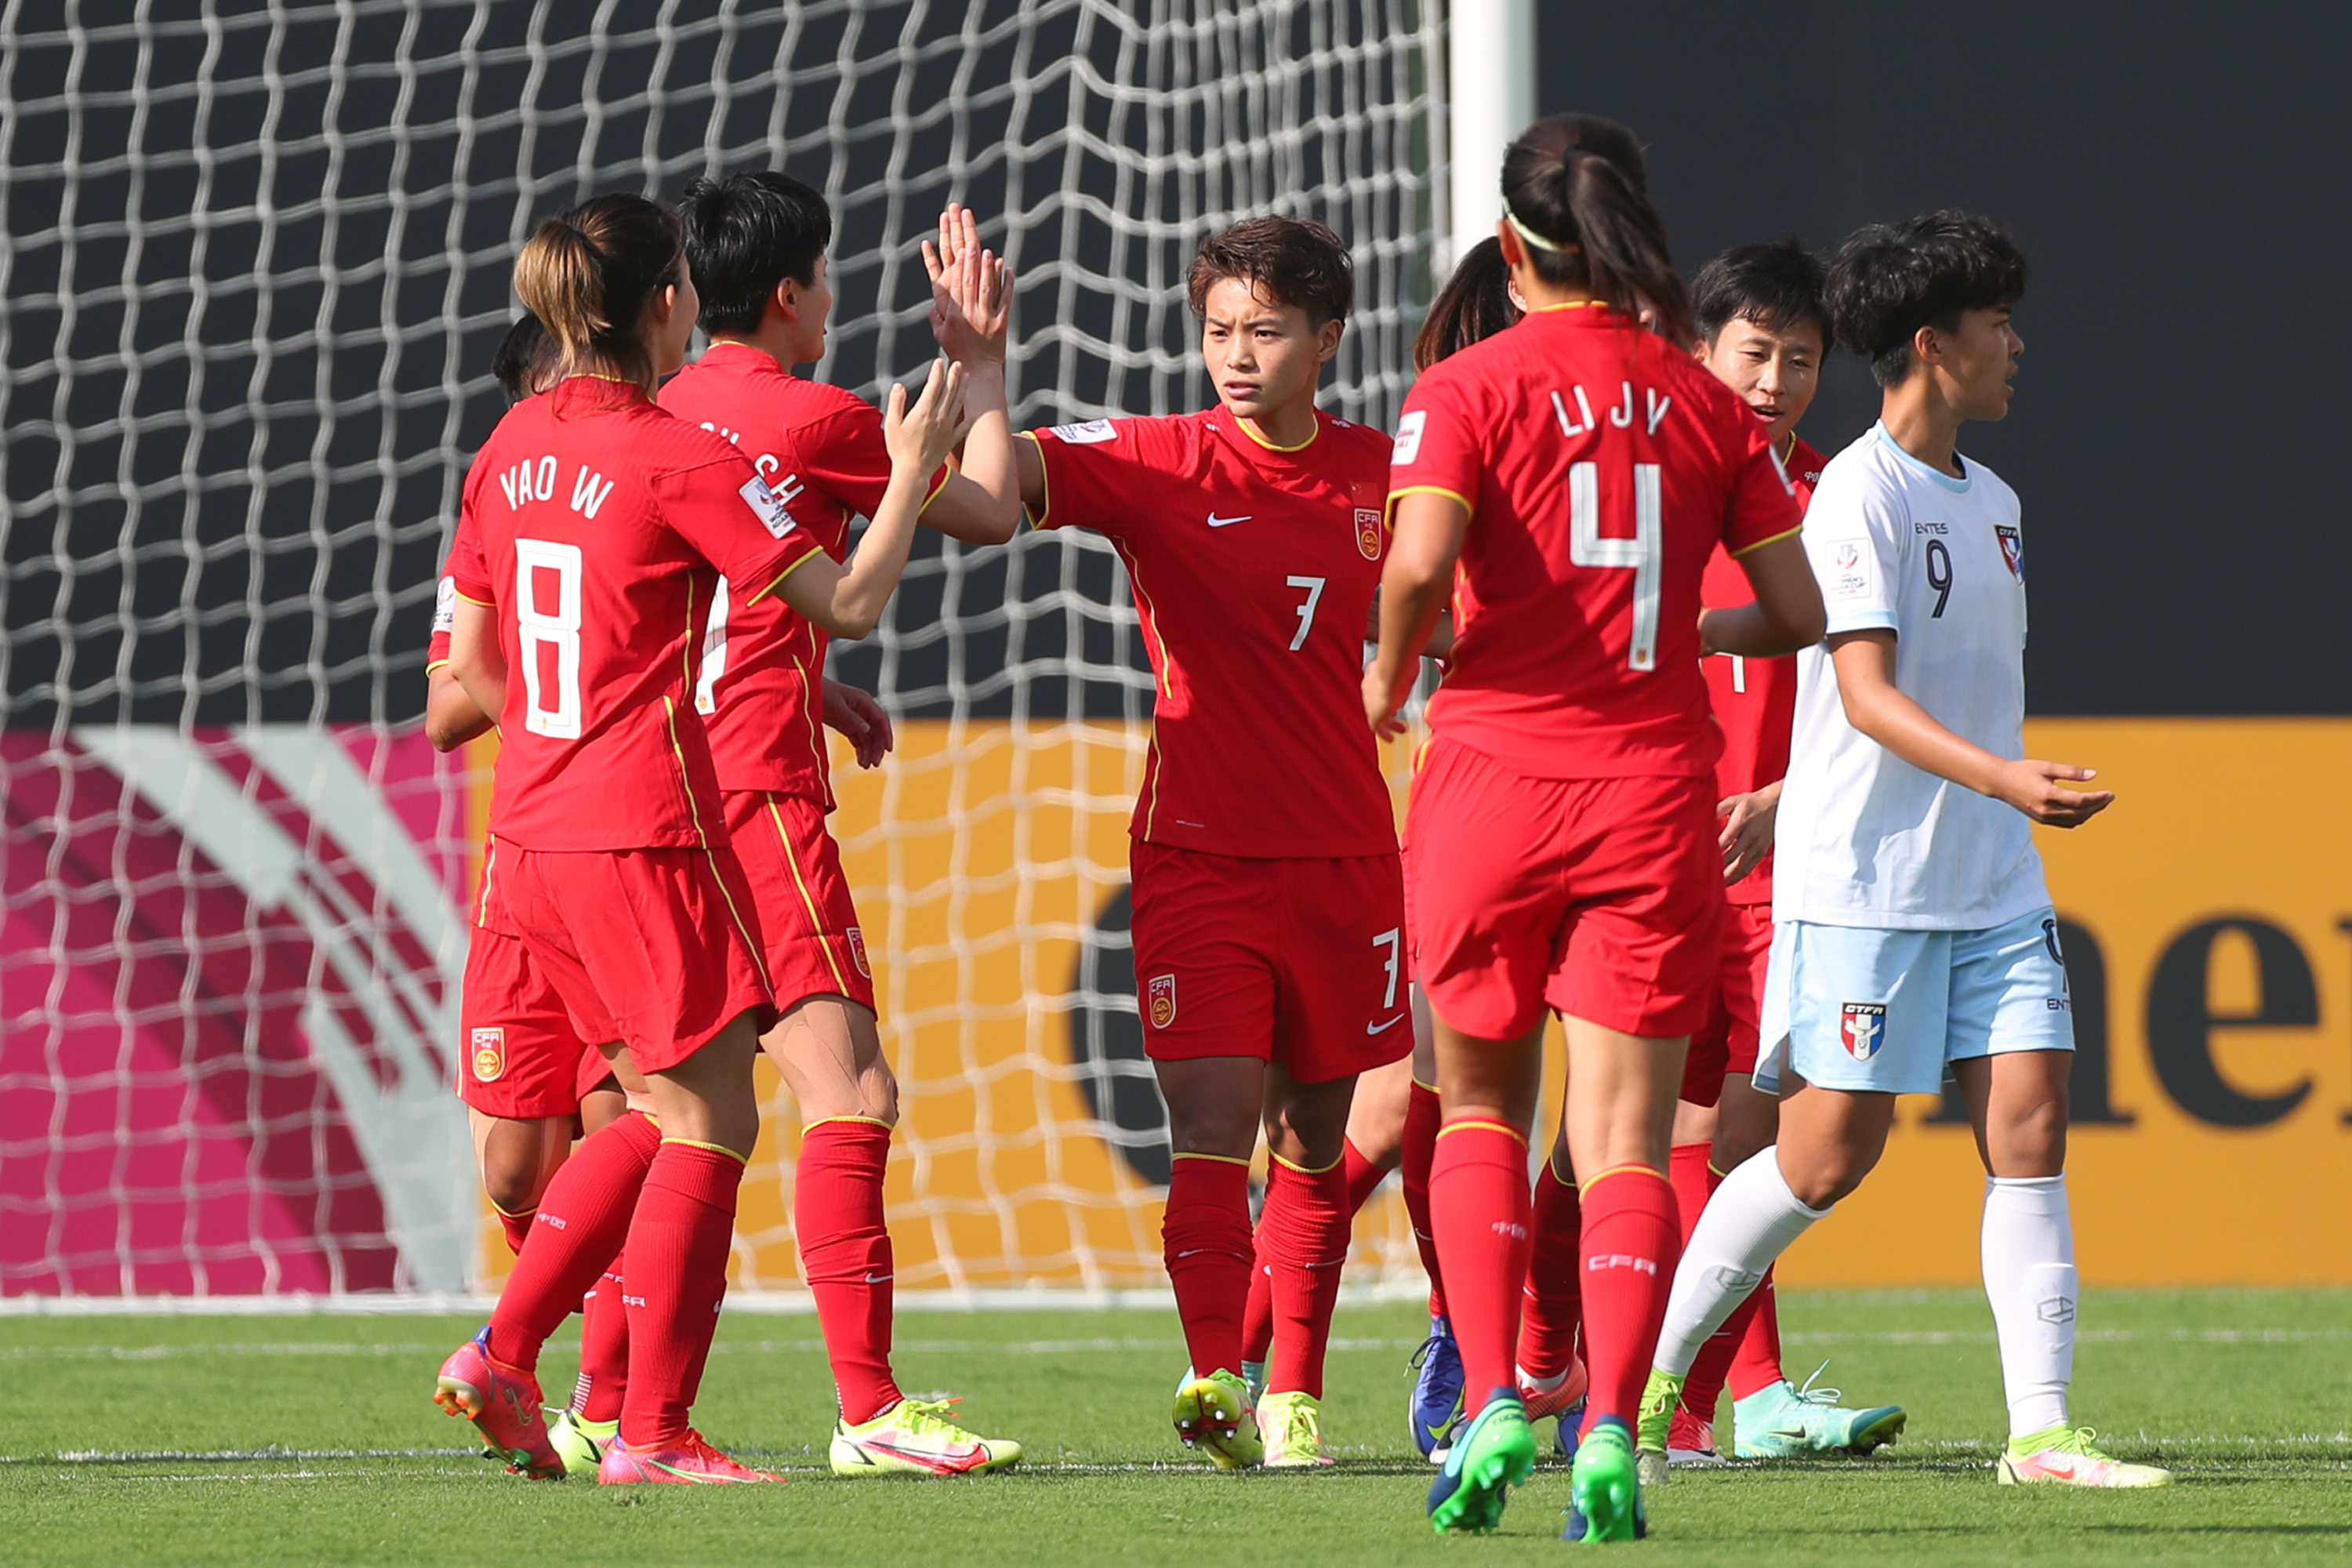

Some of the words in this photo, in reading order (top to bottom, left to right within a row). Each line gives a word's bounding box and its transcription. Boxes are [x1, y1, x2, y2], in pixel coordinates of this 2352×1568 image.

[1550, 384, 1595, 437] LI
[499, 455, 557, 511] YAO
[570, 464, 615, 520] W
[1358, 513, 1378, 523] CFA
[1915, 522, 1949, 535] ENTES
[1569, 461, 1662, 671] 4
[1926, 539, 1953, 619] 9
[514, 538, 582, 739] 8
[1287, 575, 1326, 651] 7
[1149, 979, 1171, 993] CFA
[1372, 927, 1399, 1009] 7
[1845, 1004, 1884, 1014] CTFA
[474, 1032, 500, 1044] CFA
[1588, 1254, 1657, 1276] CFA
